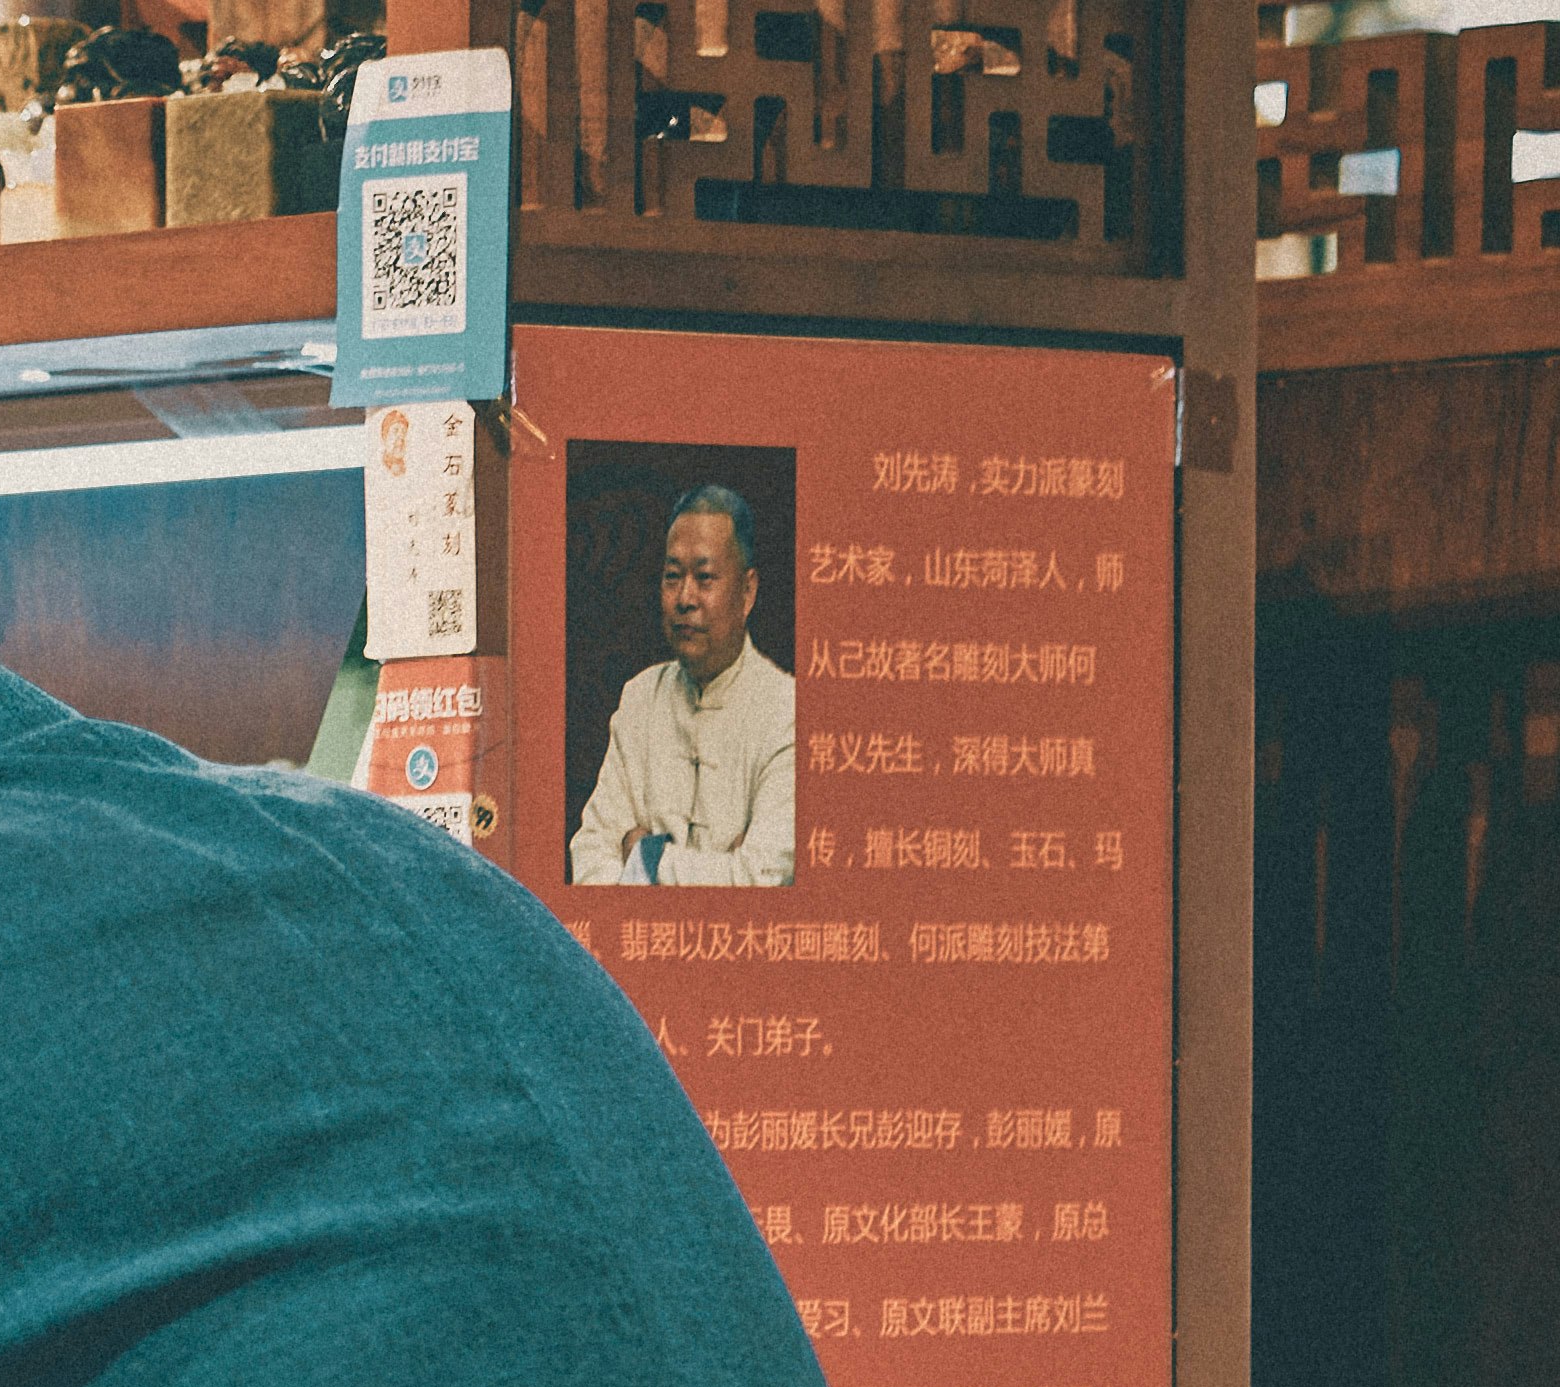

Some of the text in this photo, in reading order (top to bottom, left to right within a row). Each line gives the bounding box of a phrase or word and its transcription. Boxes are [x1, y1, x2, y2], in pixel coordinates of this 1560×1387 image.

[354, 136, 480, 170] 支付就用支付宝
[442, 413, 464, 556] 金石篆刻
[809, 732, 1097, 777] 常义先生，深得大师真
[657, 1014, 834, 1057] 人、关门弟子。
